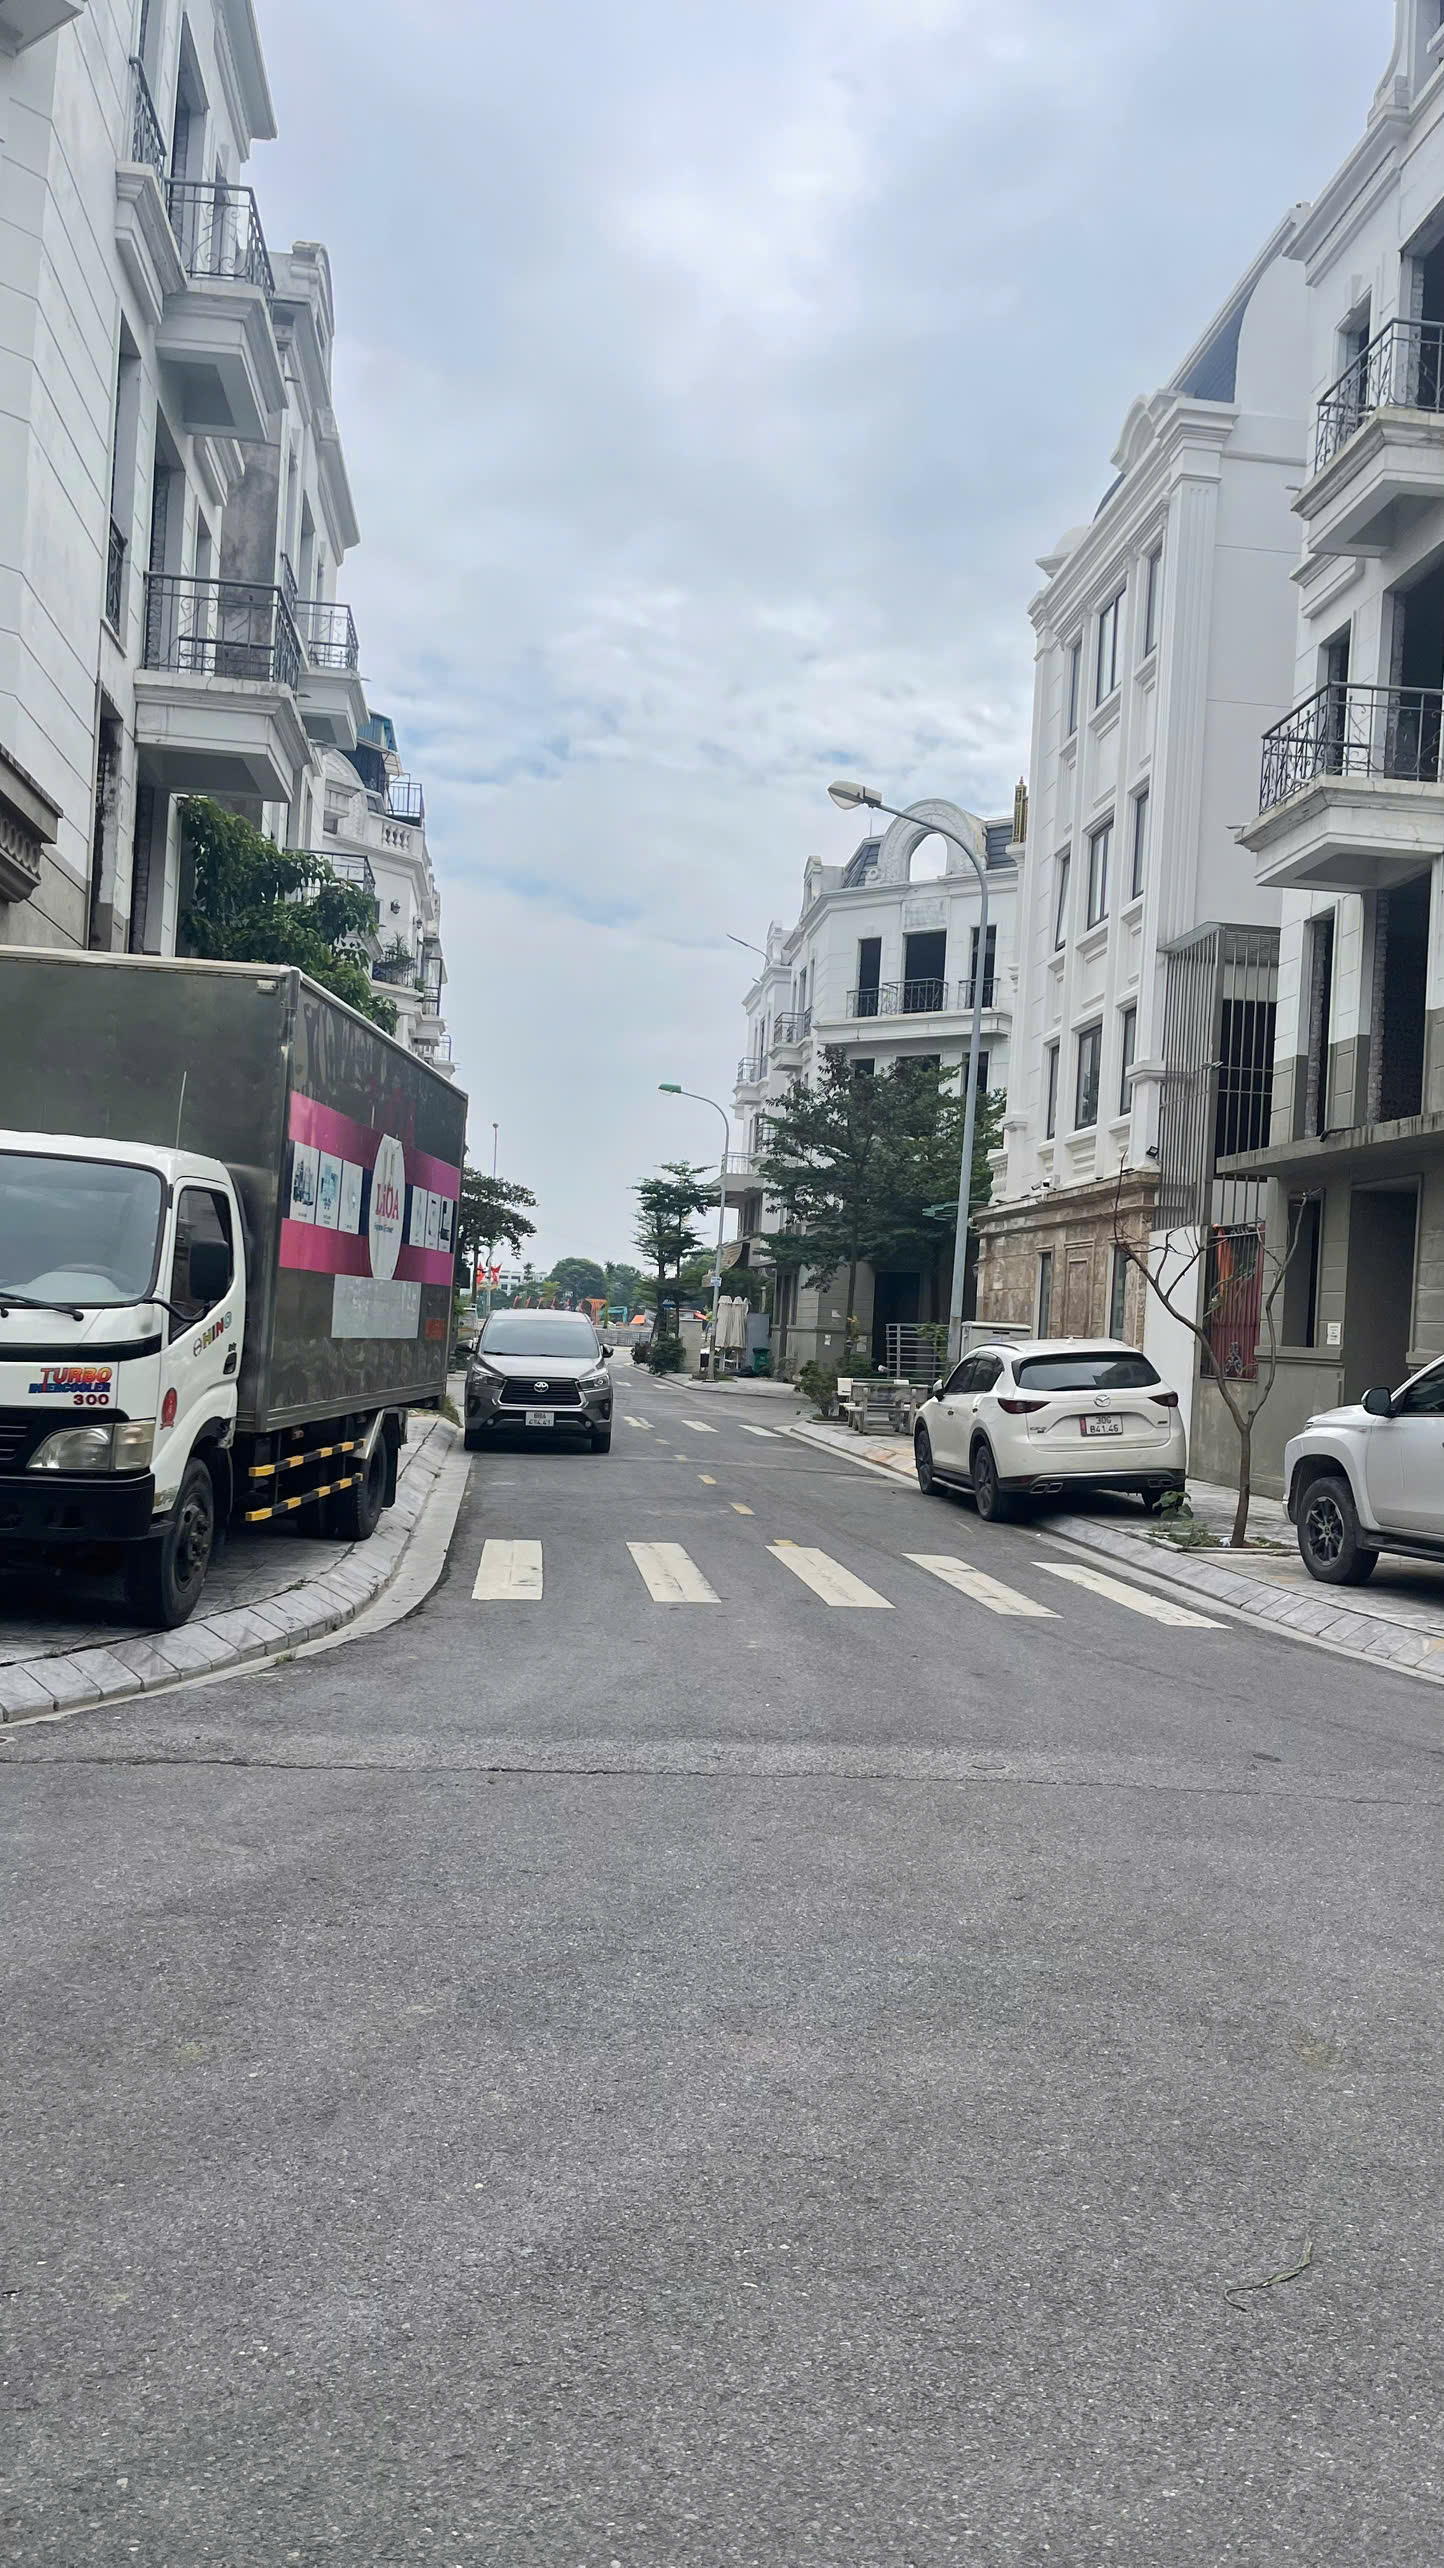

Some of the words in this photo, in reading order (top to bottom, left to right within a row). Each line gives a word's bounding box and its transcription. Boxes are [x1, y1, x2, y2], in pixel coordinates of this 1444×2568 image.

[202, 1311, 232, 1350] HINO
[40, 1367, 112, 1385] TURBO
[73, 1394, 109, 1405] 300
[1095, 1415, 1112, 1425] 30G
